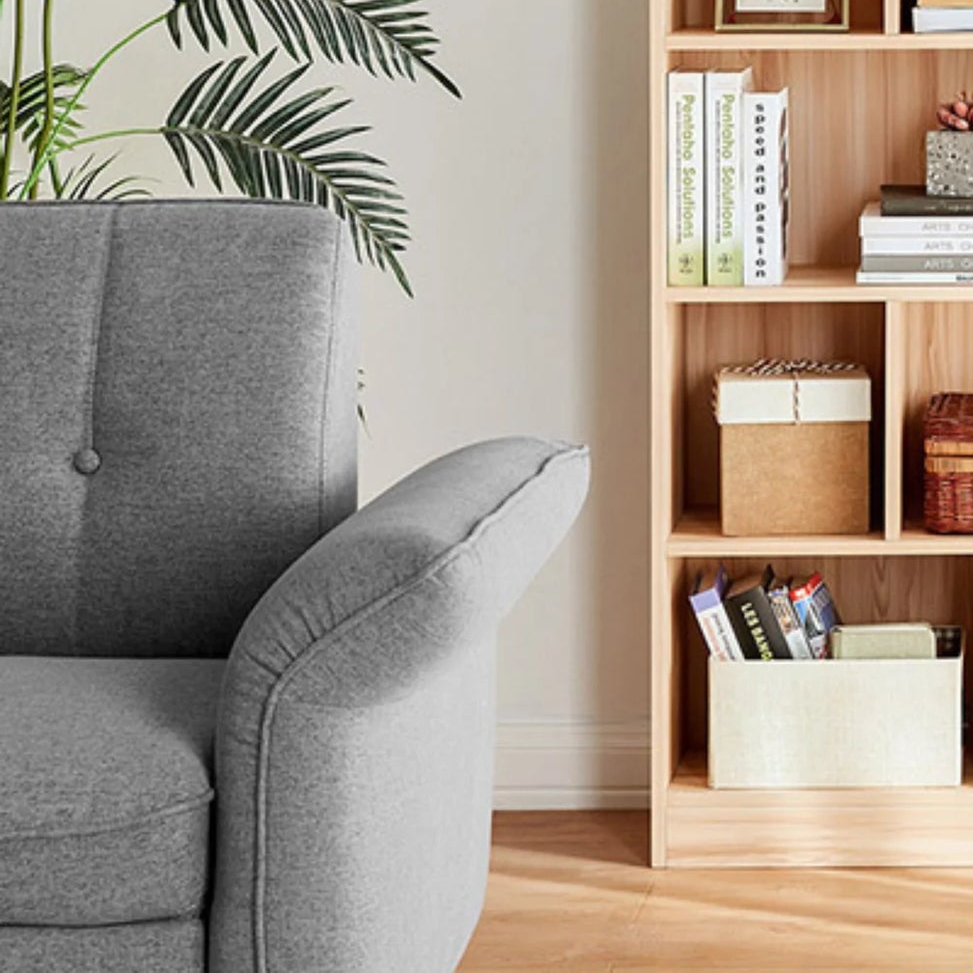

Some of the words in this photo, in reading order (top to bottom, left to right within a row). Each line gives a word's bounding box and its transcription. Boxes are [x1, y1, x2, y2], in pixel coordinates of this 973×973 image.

[682, 94, 695, 161] Pentaho
[722, 94, 735, 159] Pentaho
[754, 103, 766, 157] speed
[682, 167, 696, 238] Solutions
[722, 167, 735, 238] Solutions
[754, 164, 766, 195] and
[754, 201, 767, 278] passion
